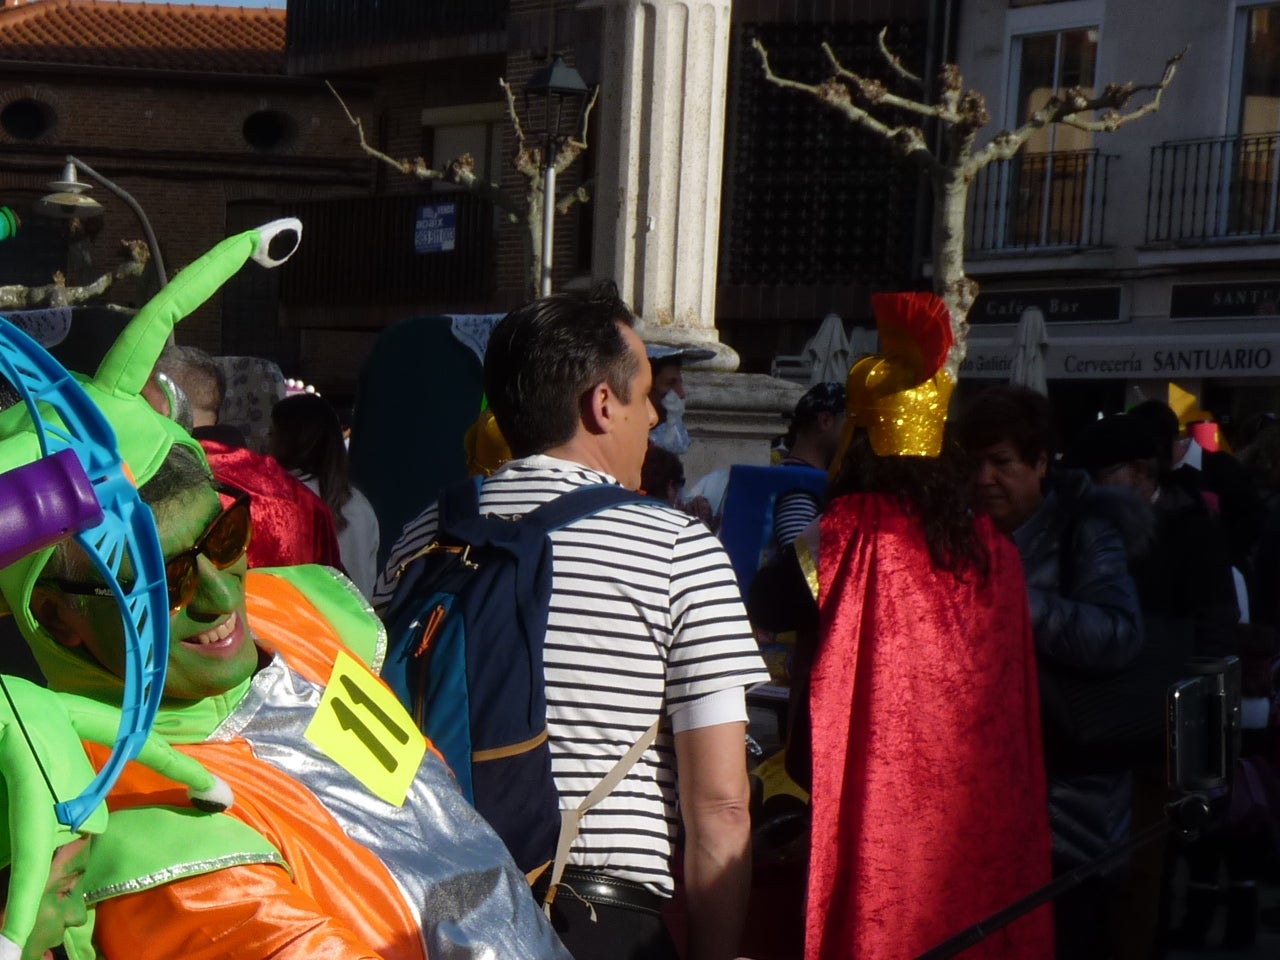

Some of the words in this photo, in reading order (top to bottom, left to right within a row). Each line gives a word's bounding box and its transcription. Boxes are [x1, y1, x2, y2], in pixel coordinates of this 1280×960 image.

[1048, 298, 1081, 314] Bar
[1064, 352, 1142, 374] Cervecería
[1153, 347, 1272, 372] SANTUARIO
[330, 674, 410, 773] 11
